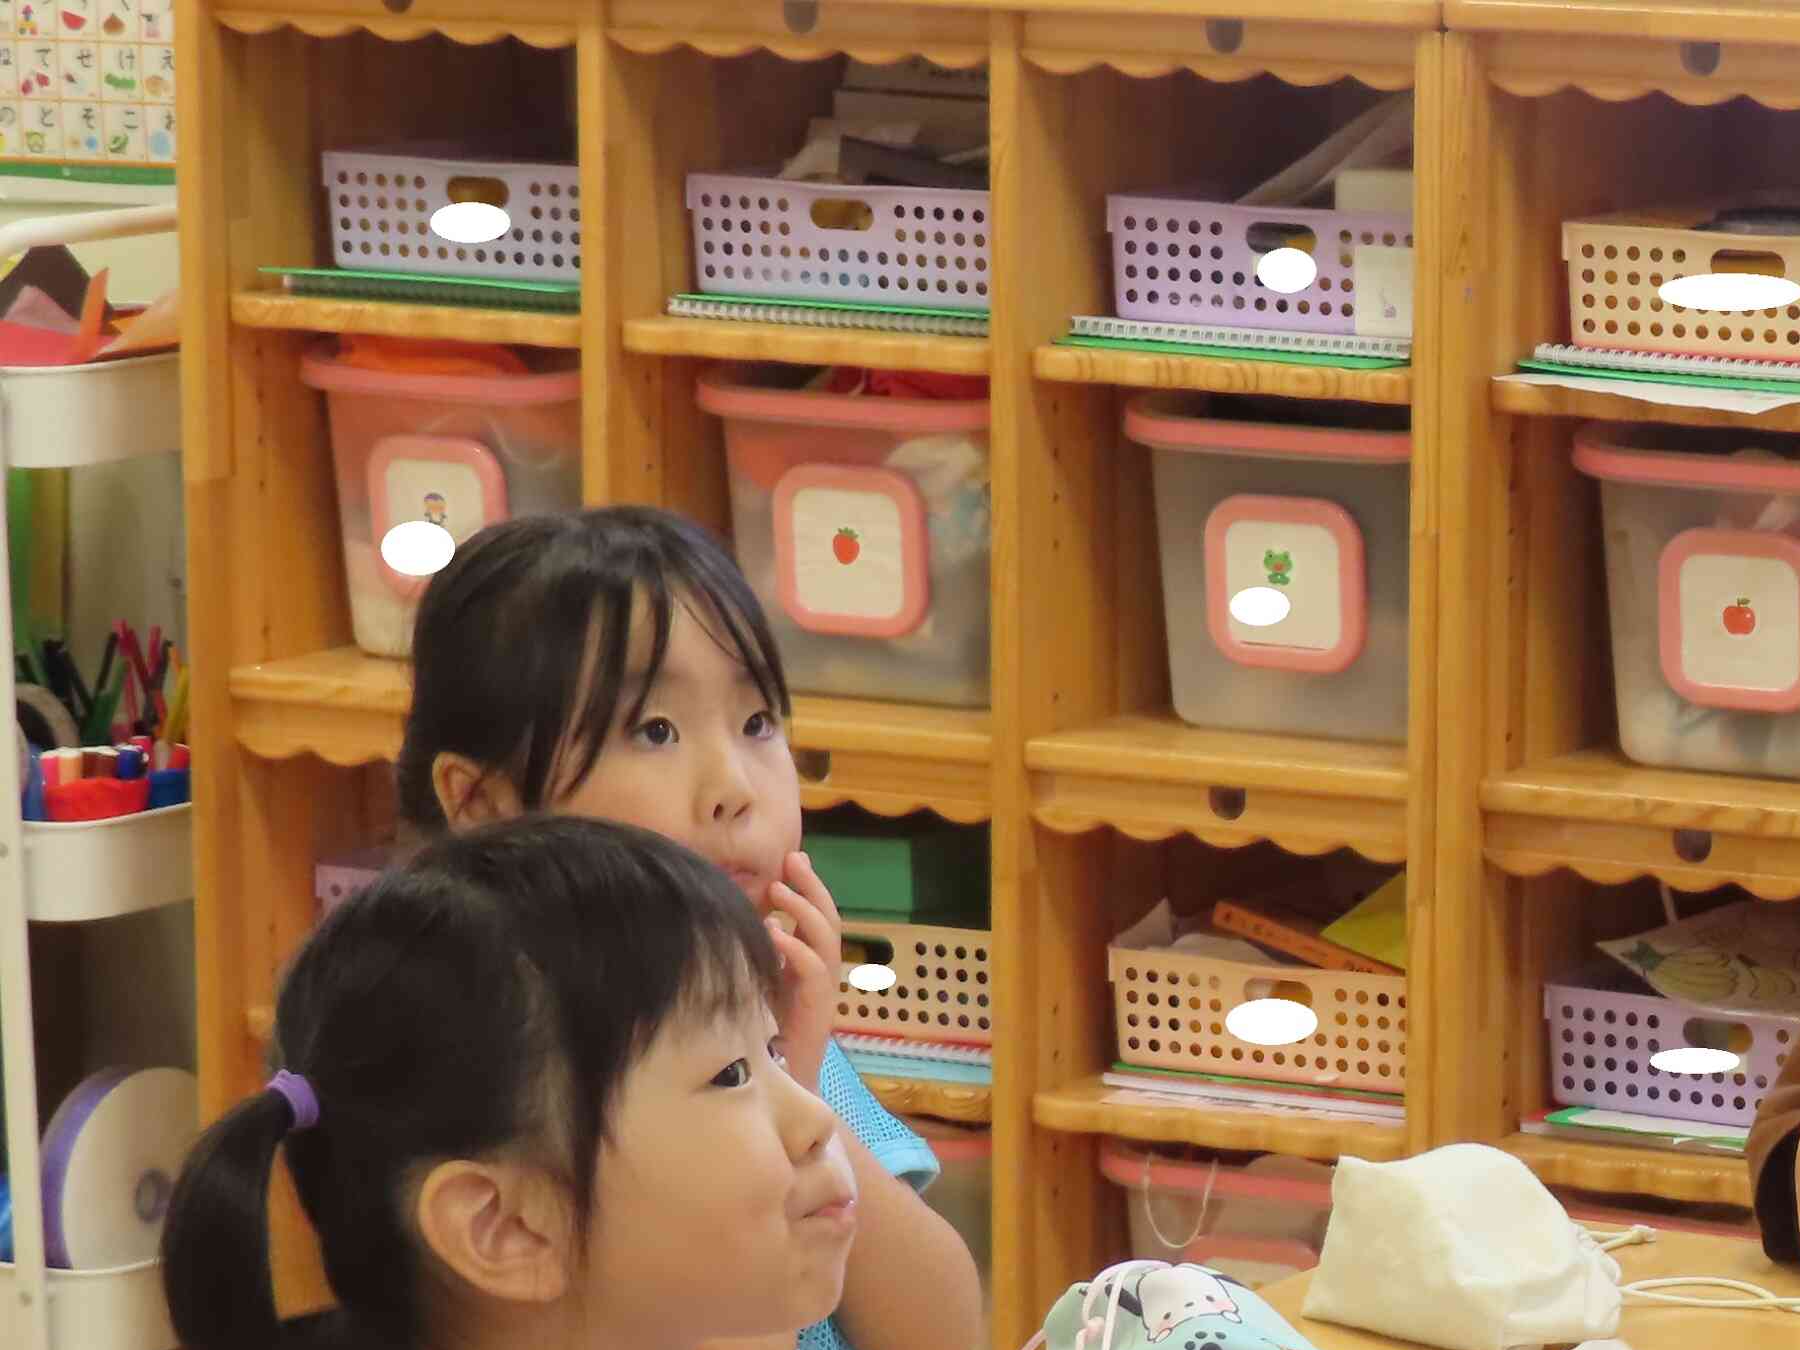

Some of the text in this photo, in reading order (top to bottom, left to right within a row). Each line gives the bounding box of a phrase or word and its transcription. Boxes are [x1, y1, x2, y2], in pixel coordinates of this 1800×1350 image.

[35, 47, 52, 68] て
[76, 48, 92, 69] せ
[118, 49, 136, 71] け
[40, 107, 55, 127] と
[81, 107, 95, 129] そ
[124, 110, 138, 129] こ
